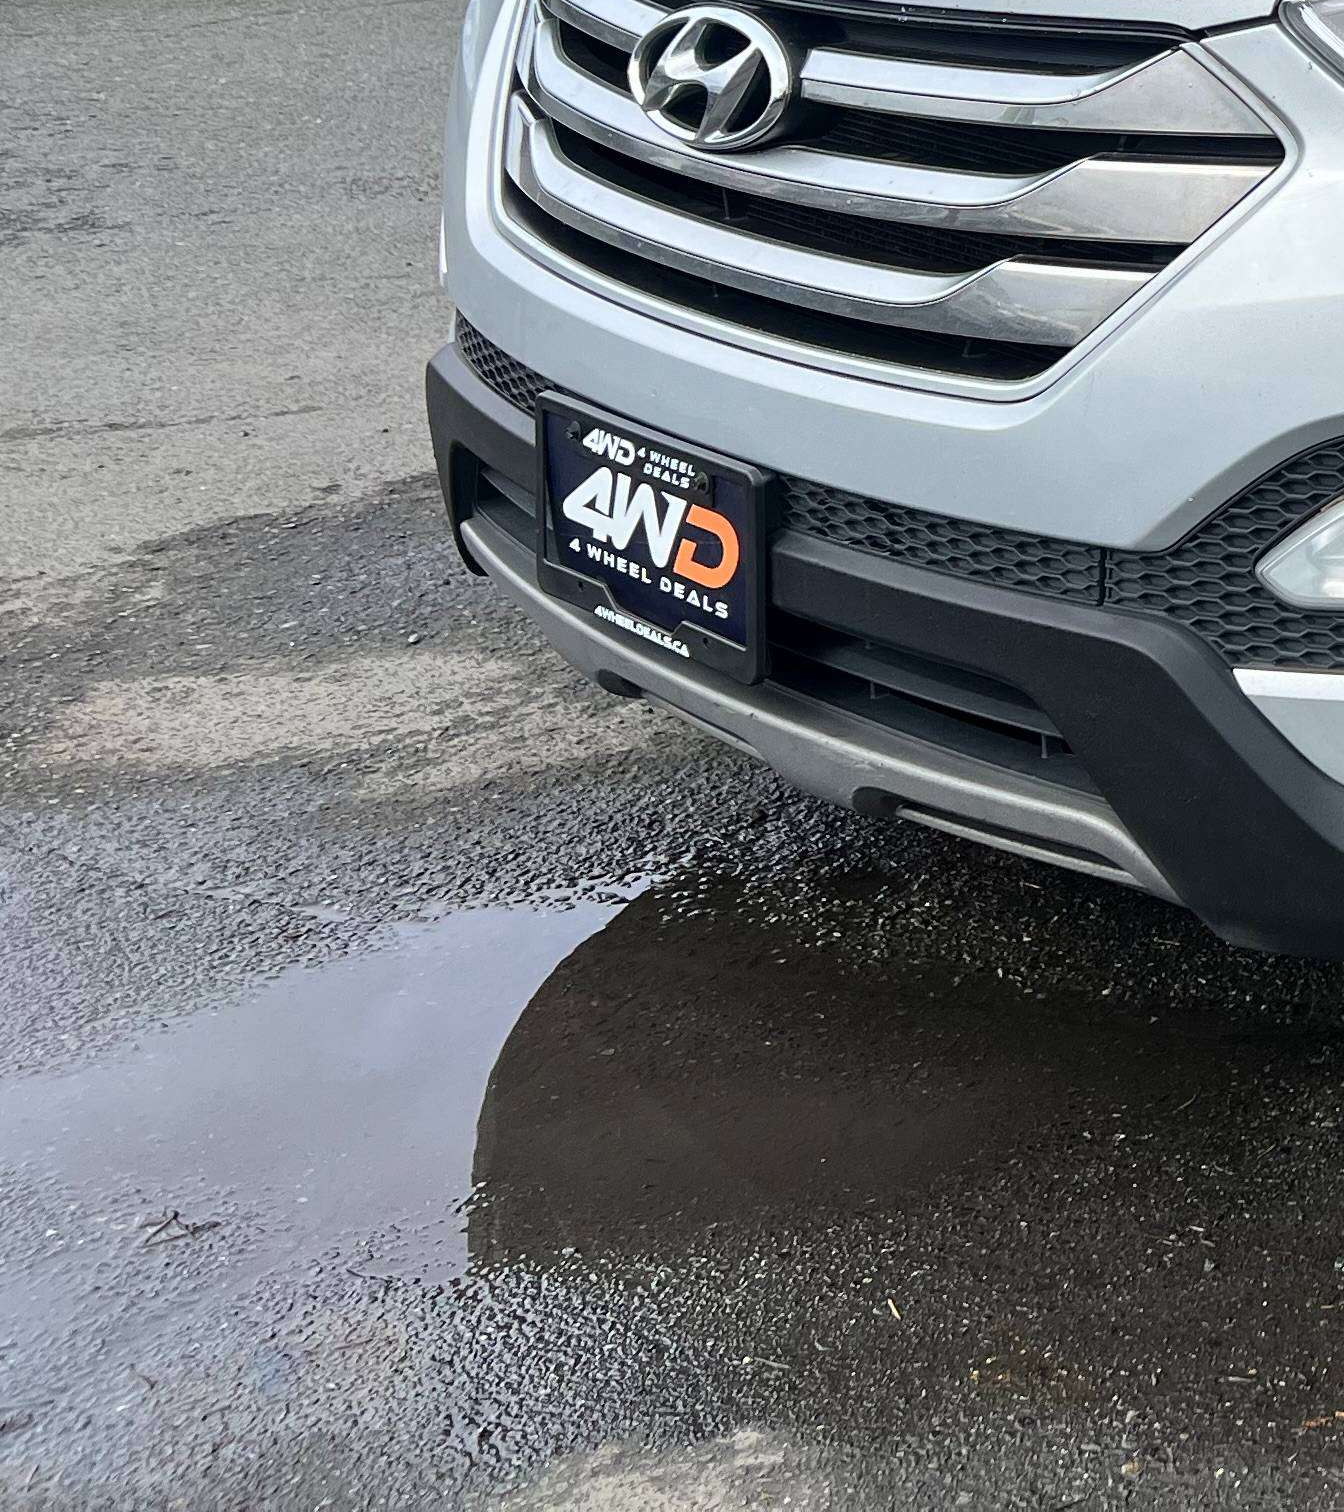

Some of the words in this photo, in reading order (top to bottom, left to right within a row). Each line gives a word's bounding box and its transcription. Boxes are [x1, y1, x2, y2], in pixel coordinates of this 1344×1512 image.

[582, 427, 636, 466] 4WD
[637, 446, 646, 458] 4
[650, 450, 697, 478] WHEEL
[643, 462, 691, 489] DEALS
[562, 465, 740, 590] 4WD
[568, 537, 580, 552] 4
[586, 543, 653, 584] WHEEL
[659, 576, 730, 620] DEALS
[594, 604, 691, 658] 4WHEELDEALS.CA
